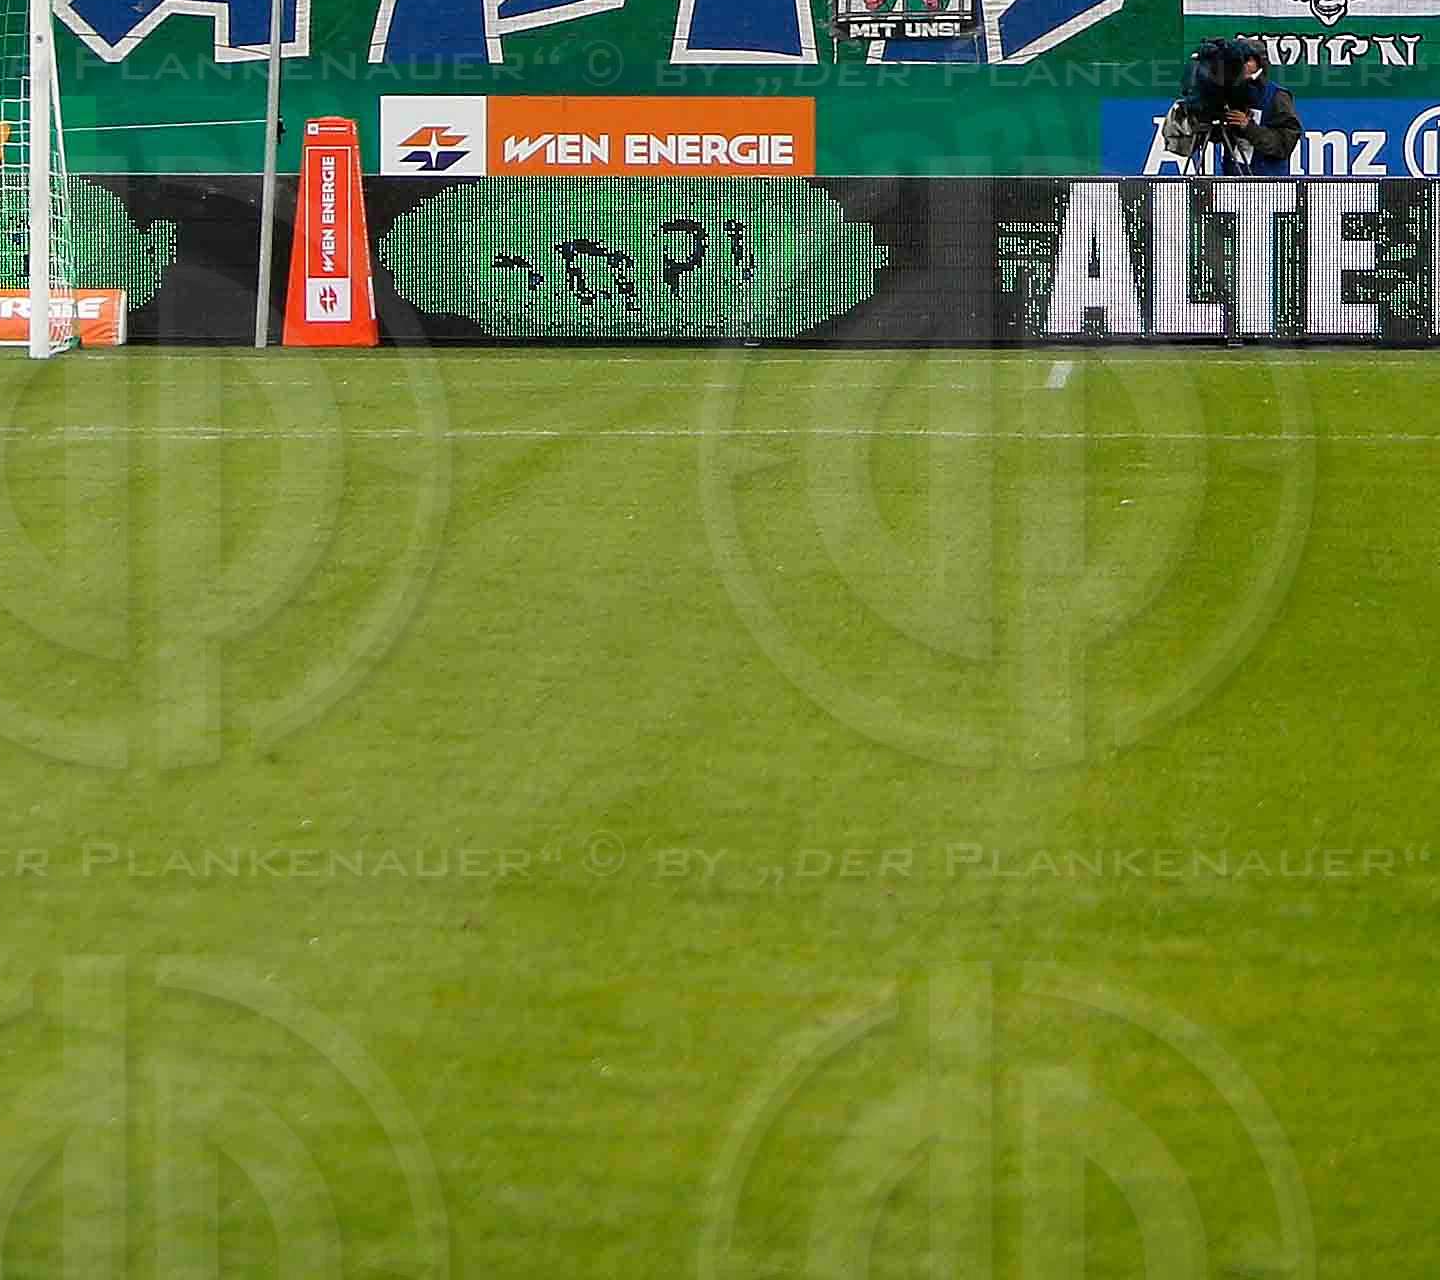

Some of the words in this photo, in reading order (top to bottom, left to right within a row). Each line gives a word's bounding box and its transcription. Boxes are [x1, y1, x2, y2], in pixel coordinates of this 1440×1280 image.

[849, 22, 897, 39] MIT
[904, 21, 962, 38] UNS!
[503, 134, 610, 167] WIEN
[625, 133, 795, 167] ENERGIE
[320, 156, 338, 225] ENERGIE
[320, 229, 338, 273] WIEN
[1043, 181, 1382, 336] ALTE
